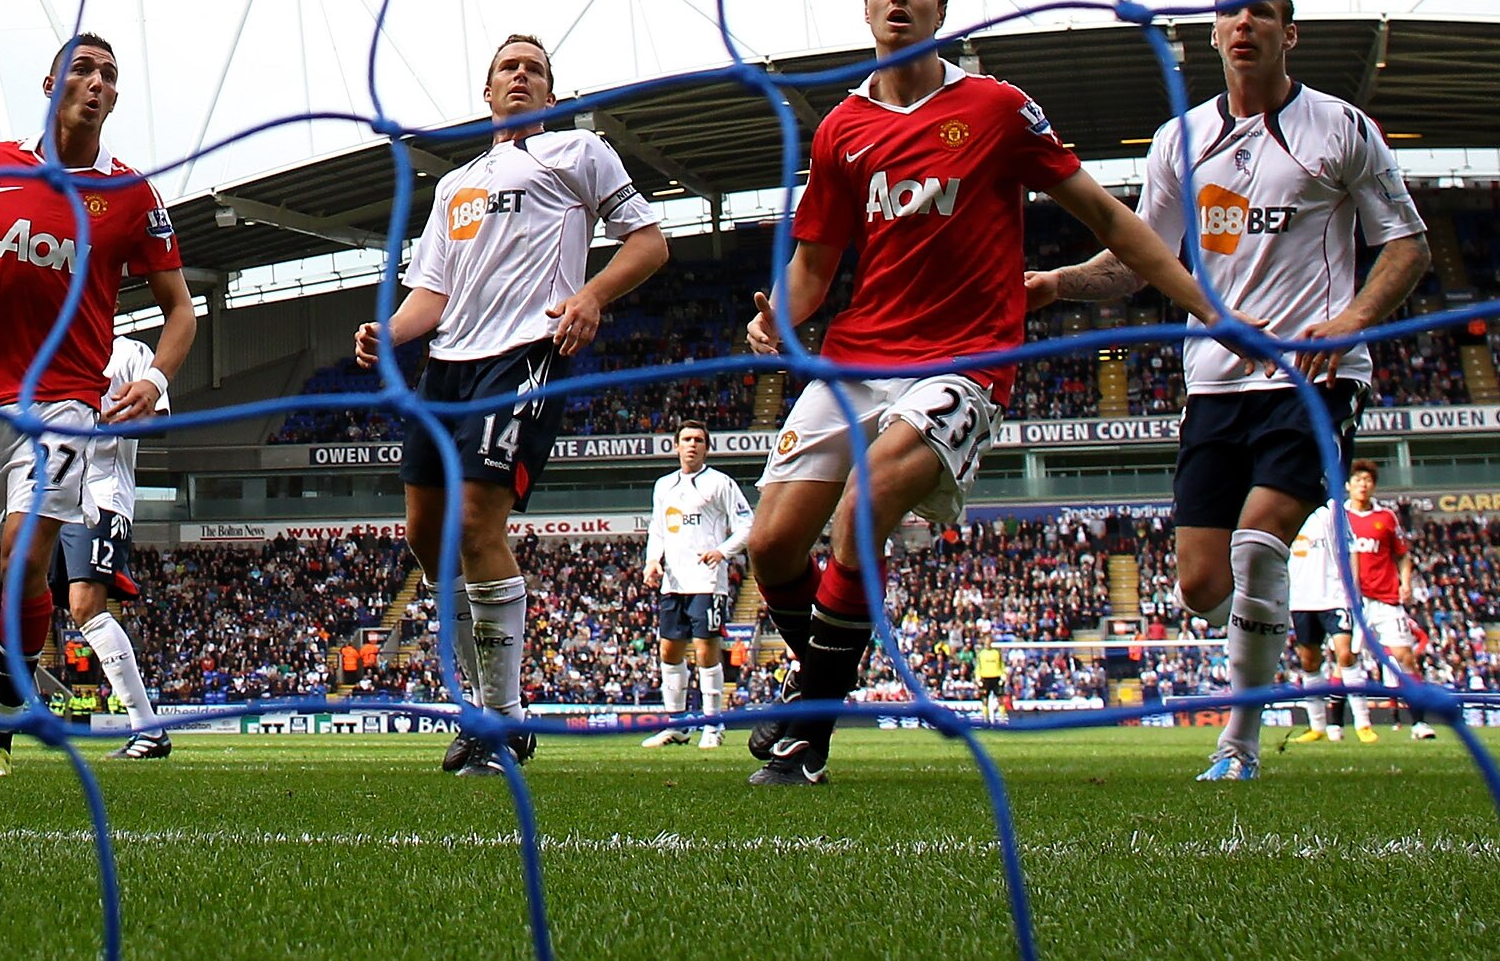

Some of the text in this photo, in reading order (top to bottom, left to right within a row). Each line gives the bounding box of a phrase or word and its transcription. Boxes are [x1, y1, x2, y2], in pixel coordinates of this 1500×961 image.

[866, 171, 961, 223] AON
[452, 189, 527, 231] 188BET
[1199, 205, 1298, 236] 188BET
[927, 387, 977, 449] 23
[1357, 411, 1403, 431] MY!
[1420, 411, 1485, 427] OWEN
[478, 413, 522, 462] 14
[1026, 426, 1089, 443] OWEN
[1097, 419, 1180, 440] COYLE'S
[315, 447, 370, 464] OWEN
[585, 438, 647, 457] ARMY!
[484, 458, 510, 471] Reebok
[202, 526, 217, 537] The
[218, 525, 243, 537] Bolton
[245, 524, 265, 536] News
[90, 538, 115, 567] 12
[706, 608, 721, 630] 16
[1232, 614, 1285, 635] BWFC
